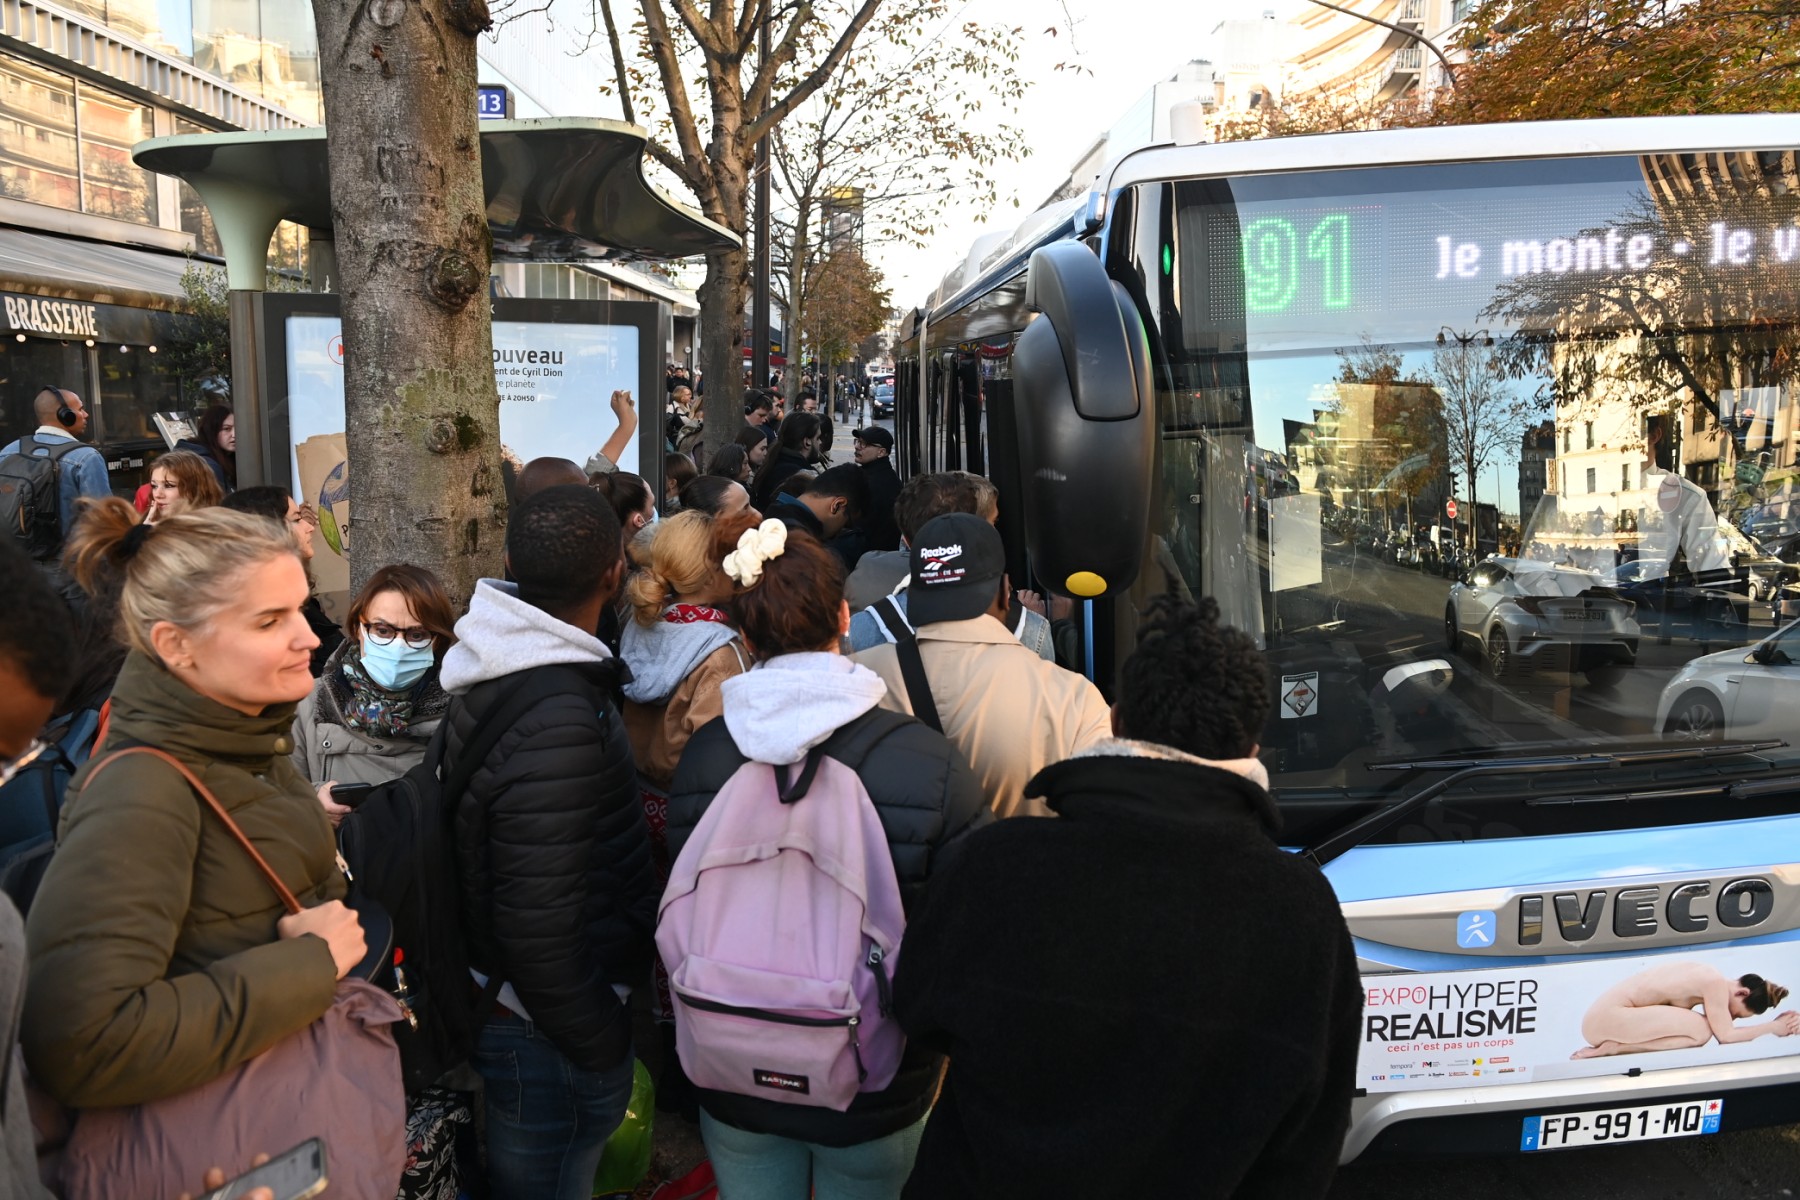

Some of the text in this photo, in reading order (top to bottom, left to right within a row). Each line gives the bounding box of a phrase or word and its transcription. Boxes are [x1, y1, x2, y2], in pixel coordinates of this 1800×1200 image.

[479, 94, 501, 112] 13
[1435, 235, 1481, 278] Je
[1502, 229, 1651, 275] monte
[1710, 222, 1751, 264] Je
[1243, 214, 1349, 311] 91
[4, 296, 98, 336] BRASSERIE
[493, 349, 563, 364] ouveau
[495, 367, 563, 378] ent de Cyril Dion
[505, 379, 535, 389] planète
[513, 394, 535, 402] 20H50
[920, 544, 962, 560] Reebok
[1518, 876, 1774, 946] IVECO
[1428, 979, 1538, 1010] HYPER
[1366, 1006, 1537, 1042] REALISME
[1387, 1038, 1514, 1053] ceci n'est pas un corps
[761, 1076, 800, 1088] EASTPAK
[1526, 1105, 1719, 1145] F FP-991-MQ 75
